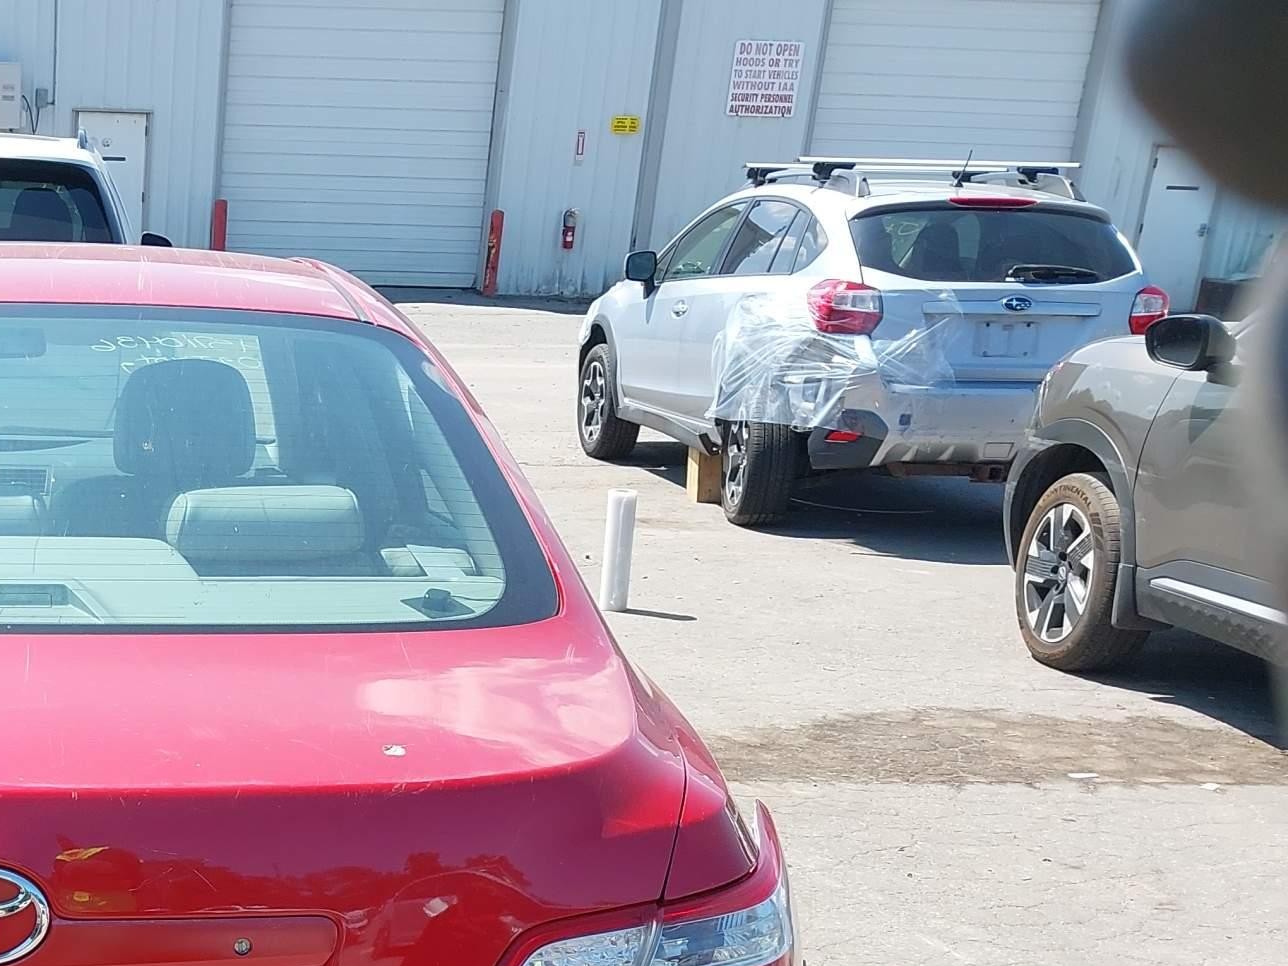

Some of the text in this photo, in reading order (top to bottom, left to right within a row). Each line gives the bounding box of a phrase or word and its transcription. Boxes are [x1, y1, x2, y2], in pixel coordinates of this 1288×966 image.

[739, 42, 800, 56] DO NOT OPEN
[735, 57, 800, 68] HOODS OR TRY
[733, 69, 799, 80] TO START VEHICLES
[732, 80, 794, 92] WITHOUT IAA
[730, 92, 794, 103] SECURITY PERSONNEL
[728, 104, 792, 115] AUTHORIZATION
